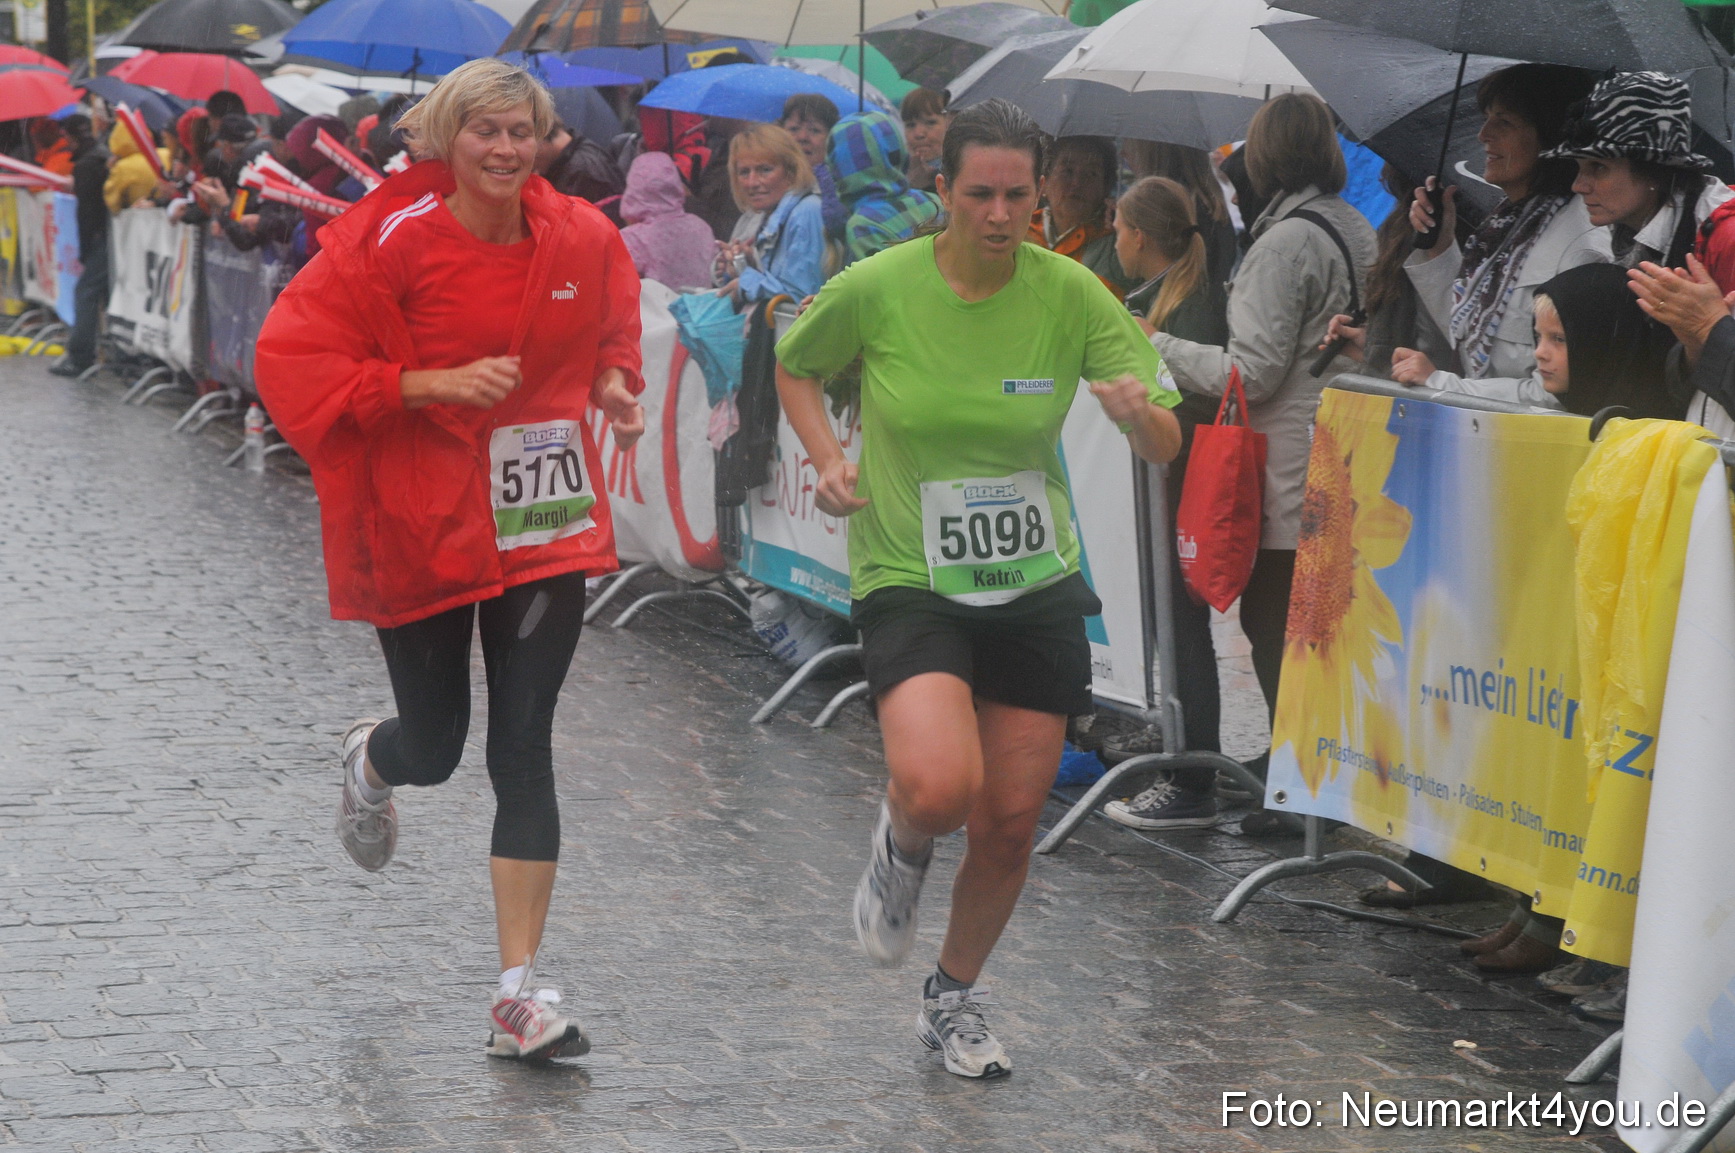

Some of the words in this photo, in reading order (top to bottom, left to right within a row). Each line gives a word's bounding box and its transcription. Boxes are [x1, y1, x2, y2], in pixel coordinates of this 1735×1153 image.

[552, 290, 574, 300] PUMA
[1017, 380, 1054, 389] PFLEIDERER
[523, 427, 569, 444] BOCK
[502, 448, 583, 503] 5170
[964, 483, 1018, 499] BOCK
[523, 505, 569, 529] Margit
[939, 504, 1046, 561] 5098
[973, 567, 1026, 588] Katrin
[1459, 783, 1504, 818] Palisaden
[1511, 800, 1543, 832] Stufen
